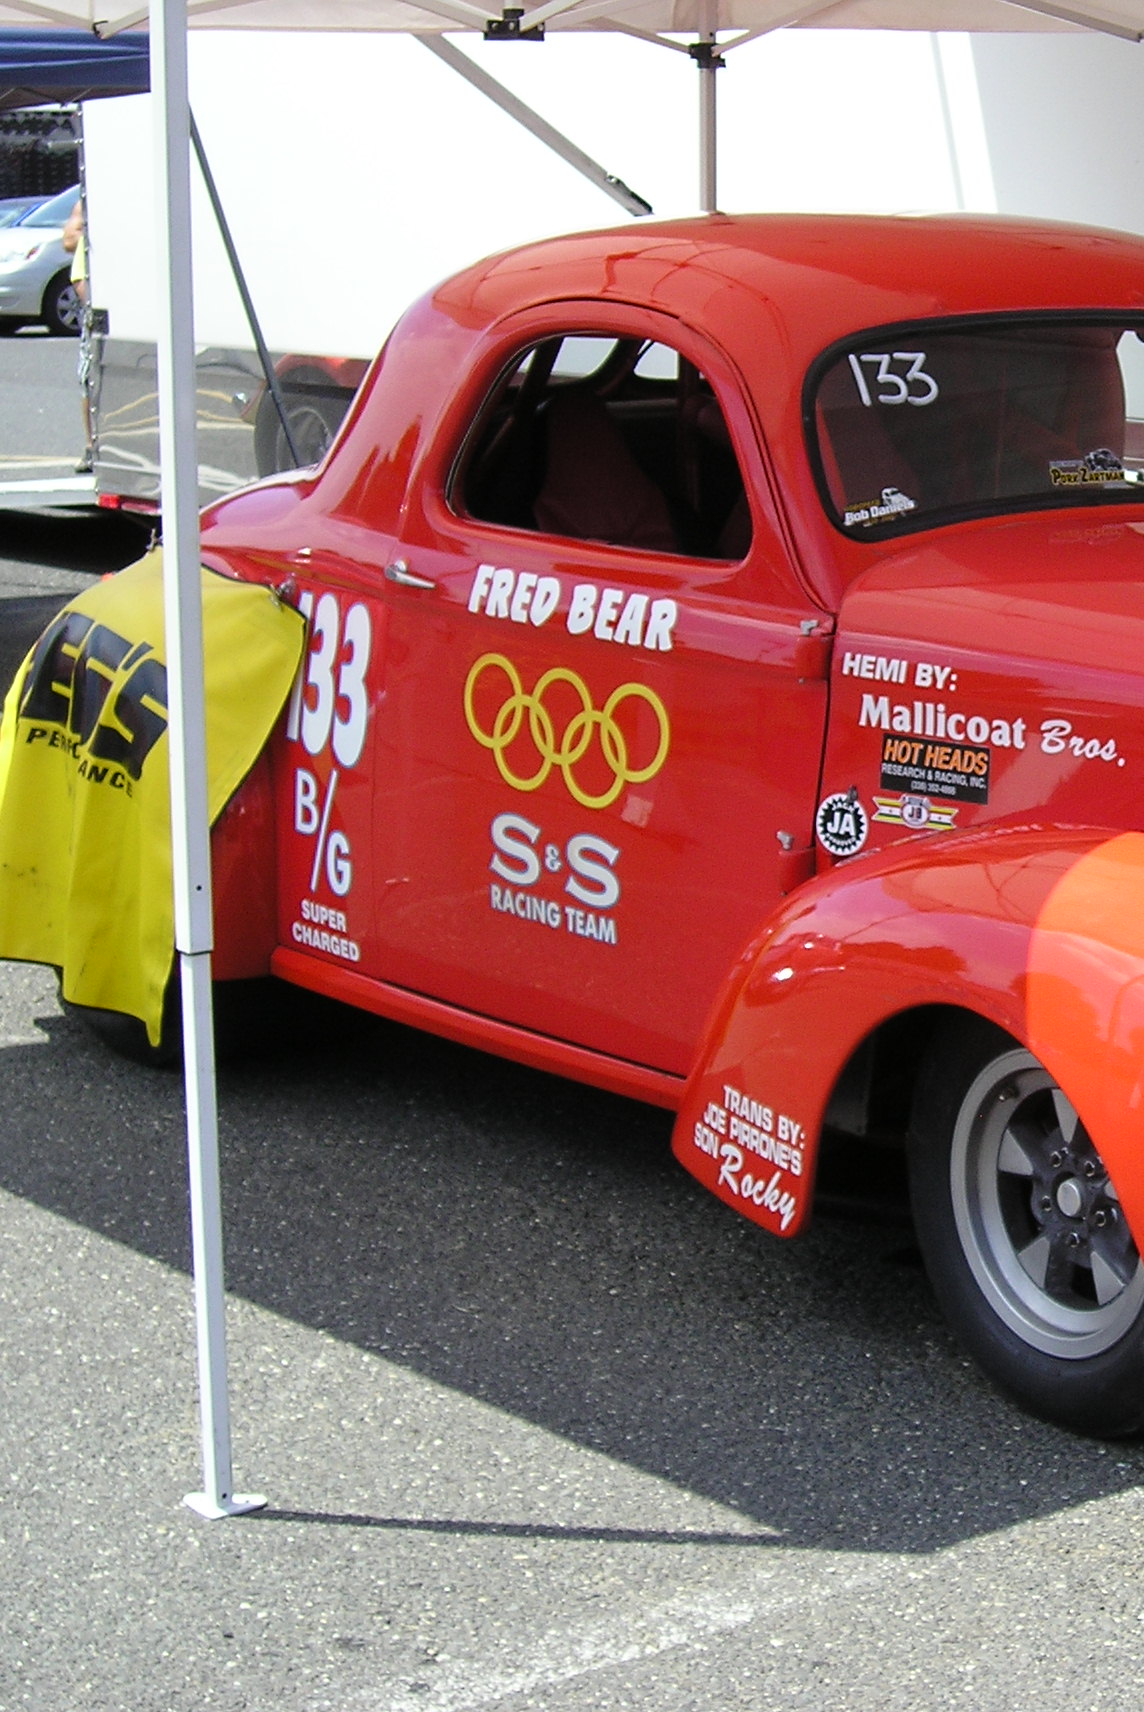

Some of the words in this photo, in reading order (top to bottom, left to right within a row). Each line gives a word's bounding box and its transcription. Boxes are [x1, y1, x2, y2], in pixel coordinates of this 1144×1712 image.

[849, 352, 939, 406] 133
[844, 509, 869, 526] Bob
[468, 564, 560, 627] FRED
[566, 584, 678, 652] BEAR
[287, 591, 371, 768] 133
[842, 652, 908, 684] HEMI
[915, 663, 957, 691] BY:
[859, 694, 1027, 750] Mallicoat
[1040, 719, 1126, 767] Bros.
[883, 739, 924, 765] HOT
[924, 745, 988, 776] HEADS
[881, 763, 925, 780] RESEARCH
[934, 771, 968, 787] RACING,
[970, 777, 987, 789] INC.
[294, 768, 352, 897] B/G
[827, 811, 856, 836] JA
[490, 811, 620, 909] S&S
[301, 899, 347, 933] SUPER
[490, 883, 561, 929] RACING
[565, 905, 617, 945] TEAM
[292, 921, 360, 963] CHARGED
[704, 1102, 726, 1135] JOE
[723, 1085, 773, 1132] TRANS
[778, 1115, 806, 1149] BY:
[694, 1122, 718, 1159] SON
[718, 1143, 796, 1231] Rocky
